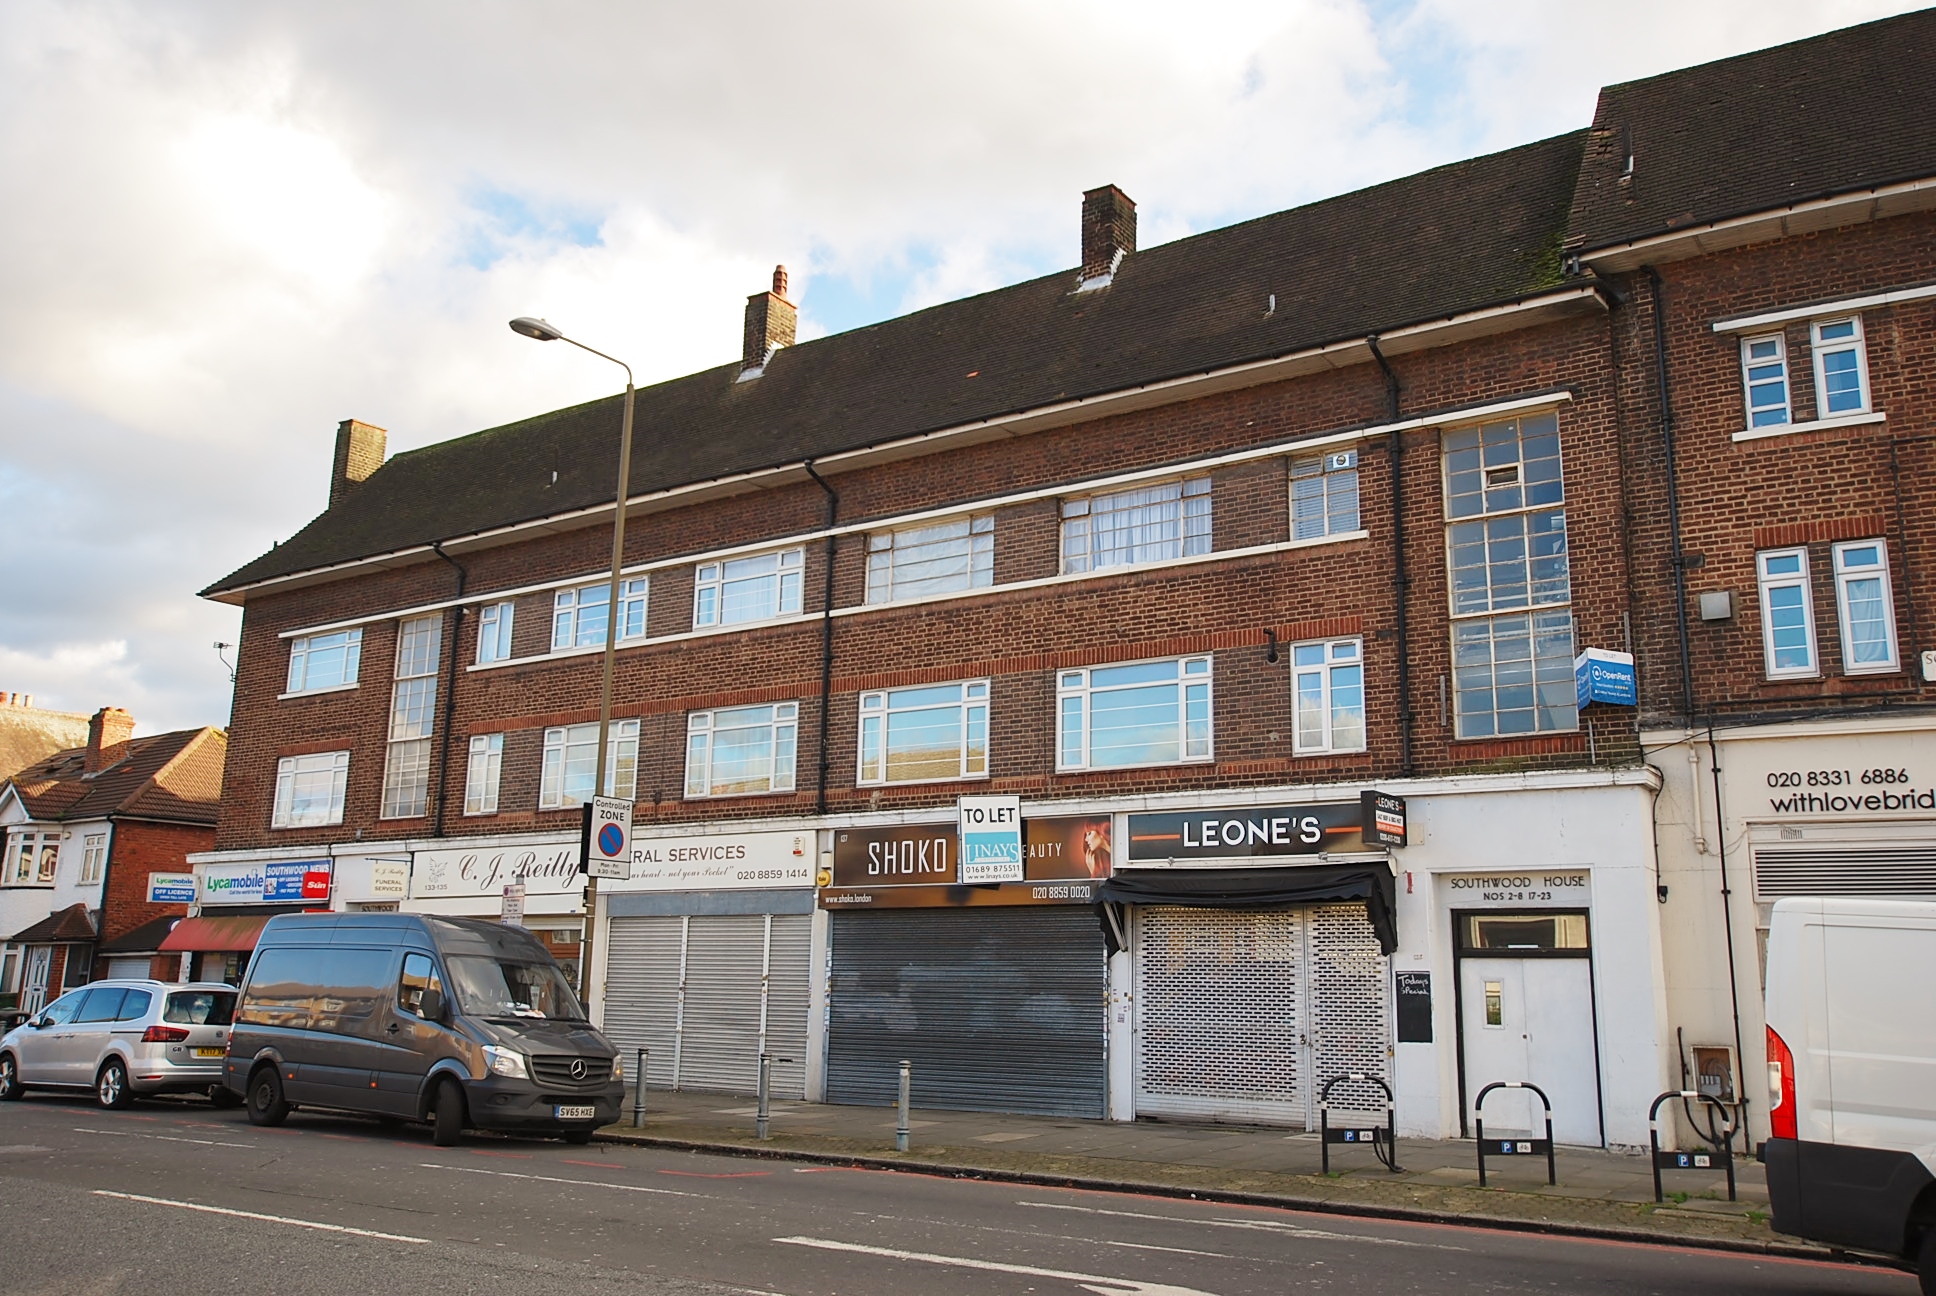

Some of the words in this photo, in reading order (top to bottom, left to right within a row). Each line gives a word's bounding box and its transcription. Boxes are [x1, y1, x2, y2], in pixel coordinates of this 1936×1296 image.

[1602, 670, 1631, 682] OpenRent
[1767, 772, 1802, 788] 020
[1807, 770, 1851, 786] 8331
[1861, 768, 1909, 784] 6886
[595, 799, 630, 811] Controlled
[1378, 796, 1399, 811] LEONE'S
[1770, 788, 1936, 813] withlovebrid
[600, 810, 625, 821] ZONE
[964, 808, 984, 824] TO
[989, 807, 1015, 823] LET
[1183, 816, 1322, 848] LEONE'S
[868, 838, 947, 875] SHOKO
[965, 842, 1019, 863] LINAYS
[267, 865, 309, 876] SOUTHWOOD
[310, 864, 329, 872] NEWS
[512, 850, 580, 888] Reilly
[668, 845, 746, 862] SERVICES
[156, 877, 193, 885] Lycamobile
[737, 871, 756, 880] 020
[757, 870, 783, 879] 8859
[786, 869, 808, 878] 1414
[207, 874, 264, 892] Lycamobile
[307, 881, 327, 889] Sun
[1451, 877, 1532, 889] SOUTHWOOD
[1544, 875, 1585, 887] HOUSE
[1032, 887, 1047, 899] 020
[1049, 886, 1069, 899] 8859
[1070, 885, 1091, 898] 0020
[1483, 892, 1504, 901] NOS
[1508, 892, 1523, 900] 2-8
[1528, 891, 1552, 900] 17-23
[560, 1107, 579, 1116] SV65
[580, 1107, 594, 1116] HXE
